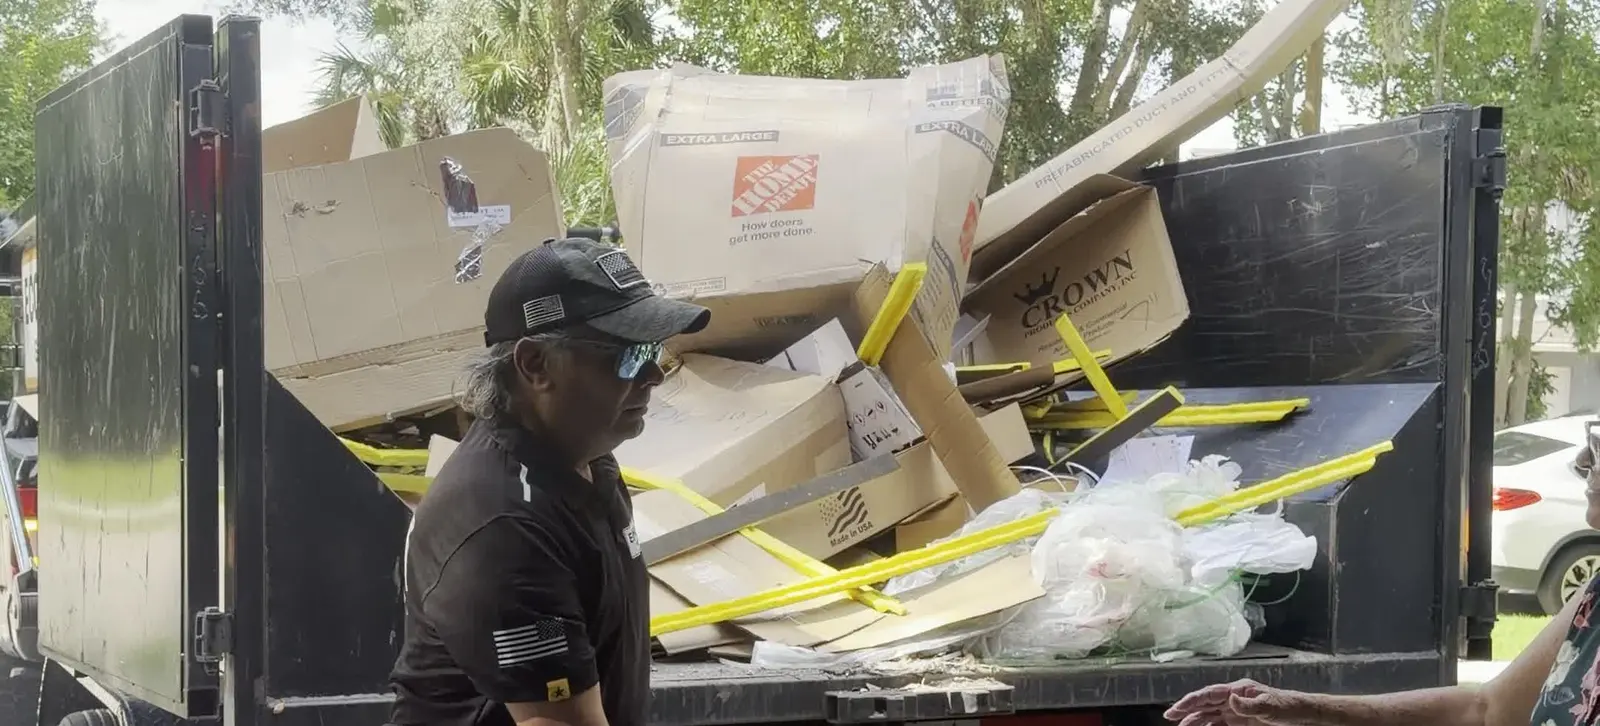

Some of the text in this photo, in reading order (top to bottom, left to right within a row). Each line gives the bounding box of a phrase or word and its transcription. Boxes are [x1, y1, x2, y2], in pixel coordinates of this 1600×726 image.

[666, 131, 775, 145] EXTRA LARGE
[920, 121, 969, 140] EXTRA
[1034, 126, 1133, 189] PREFABRICATED
[1135, 103, 1168, 128] DUCT
[1170, 85, 1197, 105] AND
[742, 160, 778, 184] THE
[732, 155, 819, 215] HOME
[764, 173, 817, 212] DEPOT
[741, 217, 804, 232] How doers
[728, 234, 749, 246] get
[750, 229, 781, 241] more
[1022, 249, 1133, 328] CROWN
[830, 521, 873, 547] Made in USA
